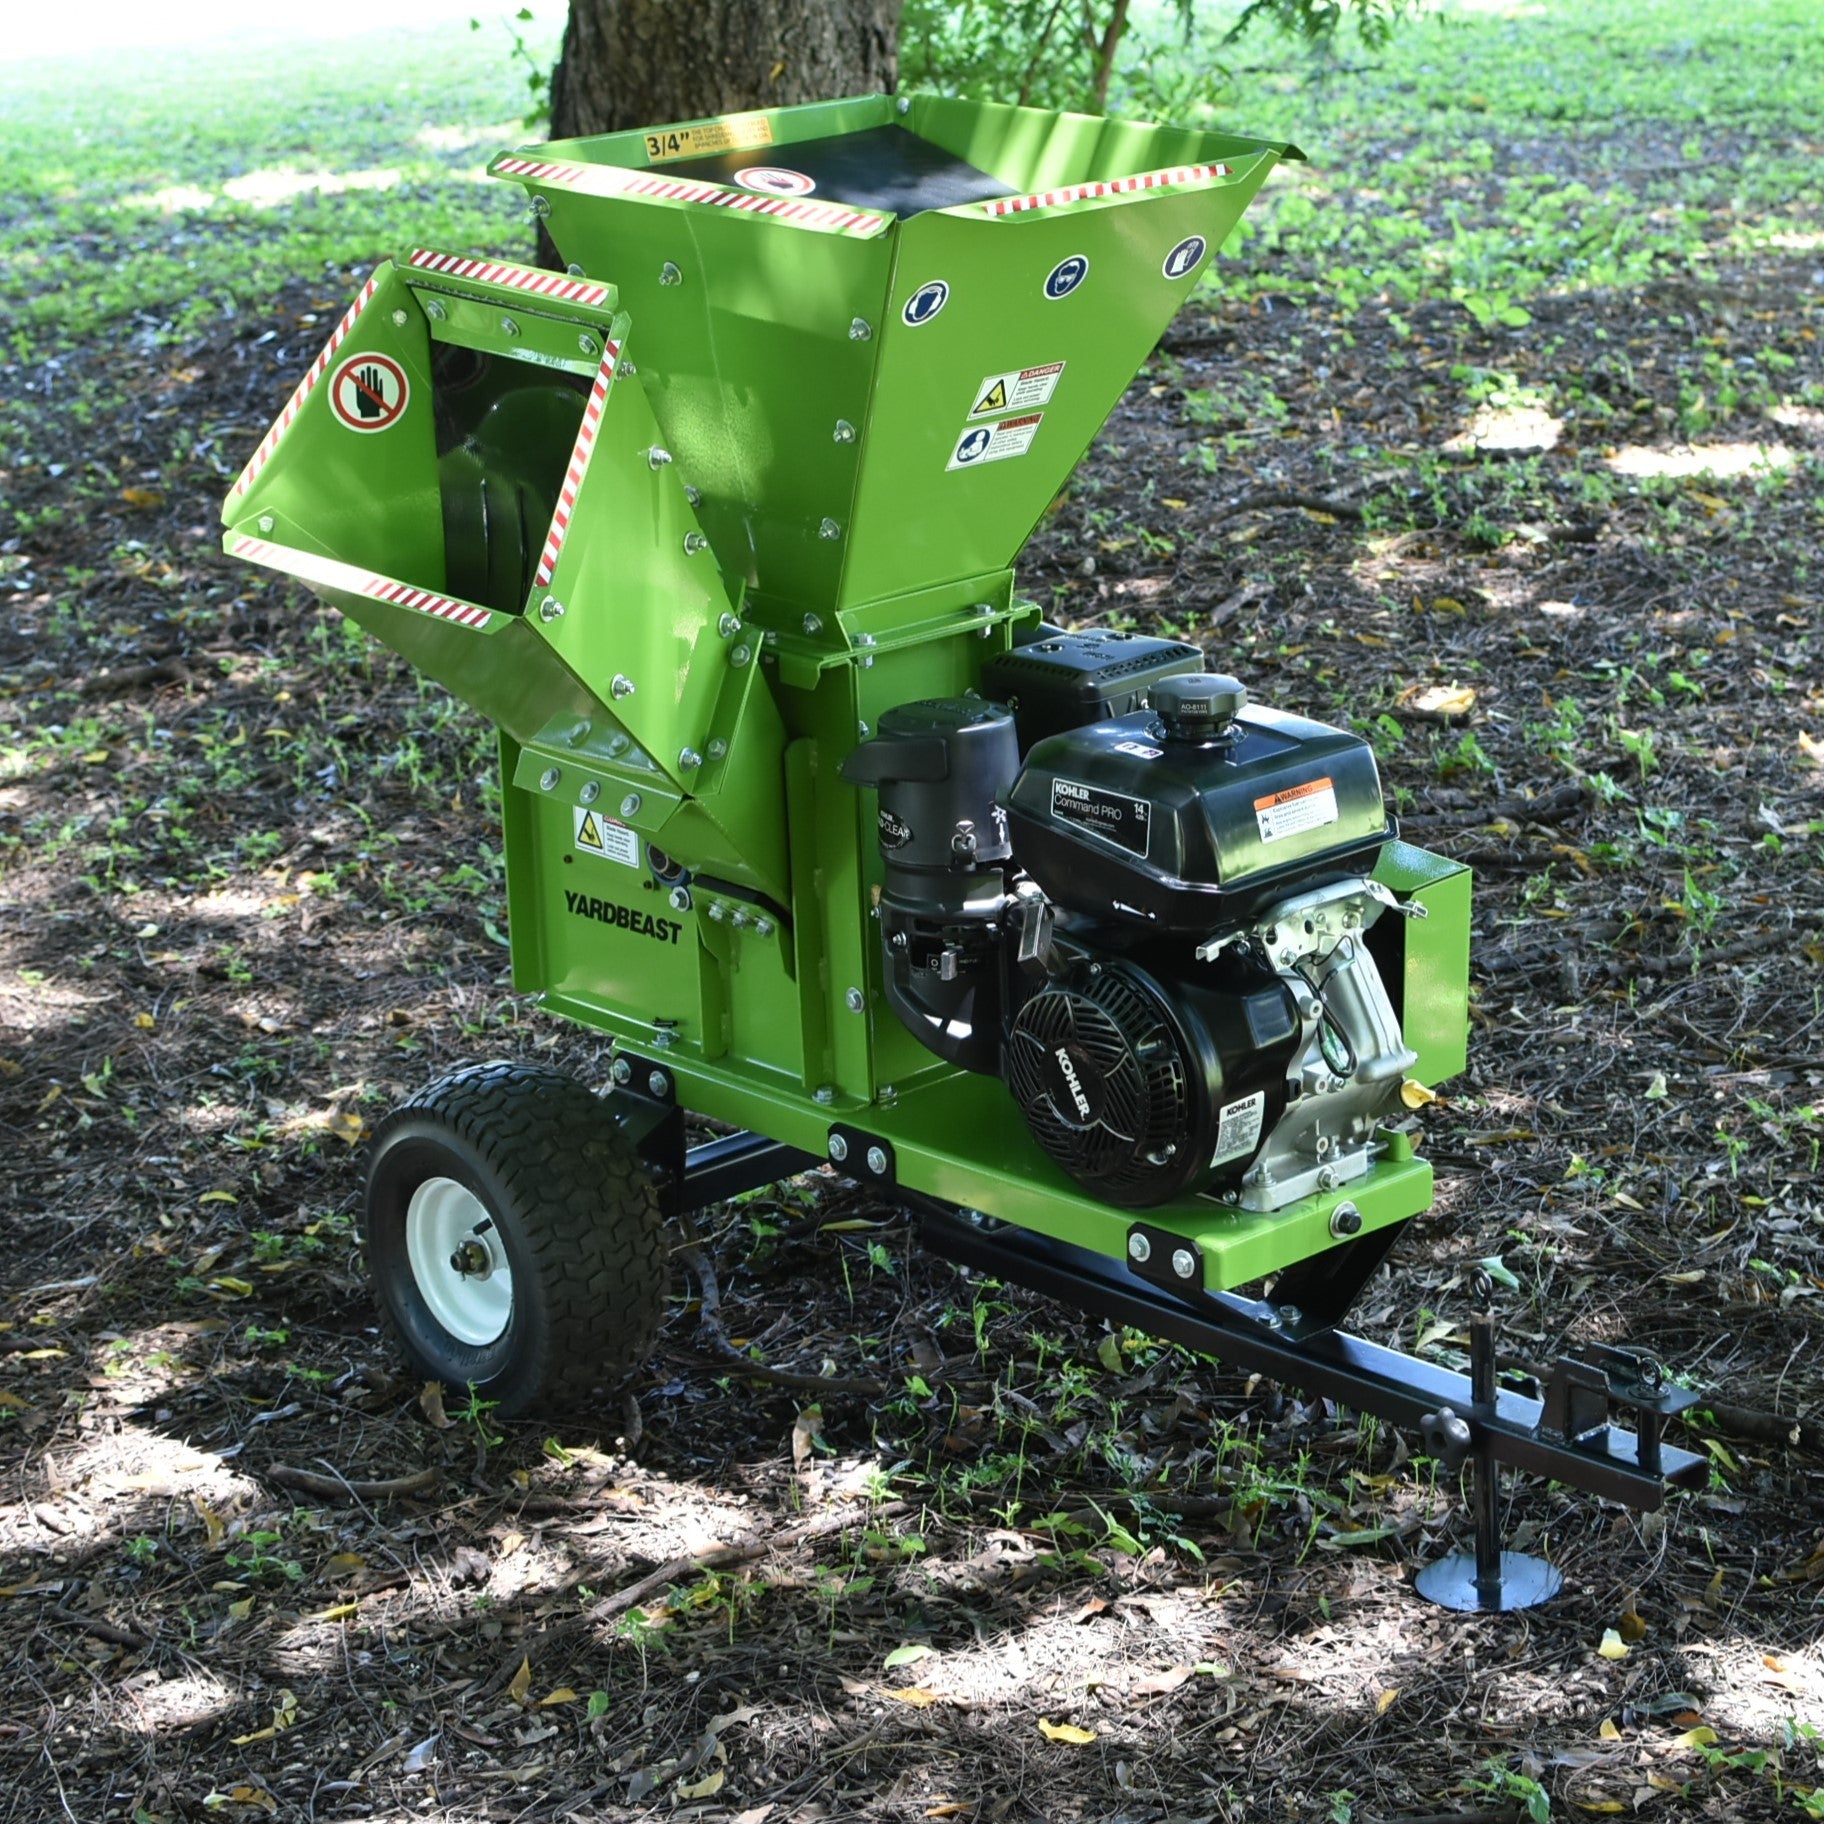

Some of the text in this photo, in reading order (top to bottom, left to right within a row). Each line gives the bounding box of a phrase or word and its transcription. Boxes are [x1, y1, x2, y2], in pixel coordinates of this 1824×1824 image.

[1028, 364, 1061, 377] DANGER
[1055, 782, 1090, 801] KOHLER
[1281, 785, 1313, 800] WARNING
[1055, 794, 1122, 820] Command PRO
[1134, 803, 1144, 814] 14
[564, 889, 683, 945] YARDBEAST
[1055, 1047, 1090, 1121] KOHLER
[1227, 1098, 1256, 1116] KOHLER
